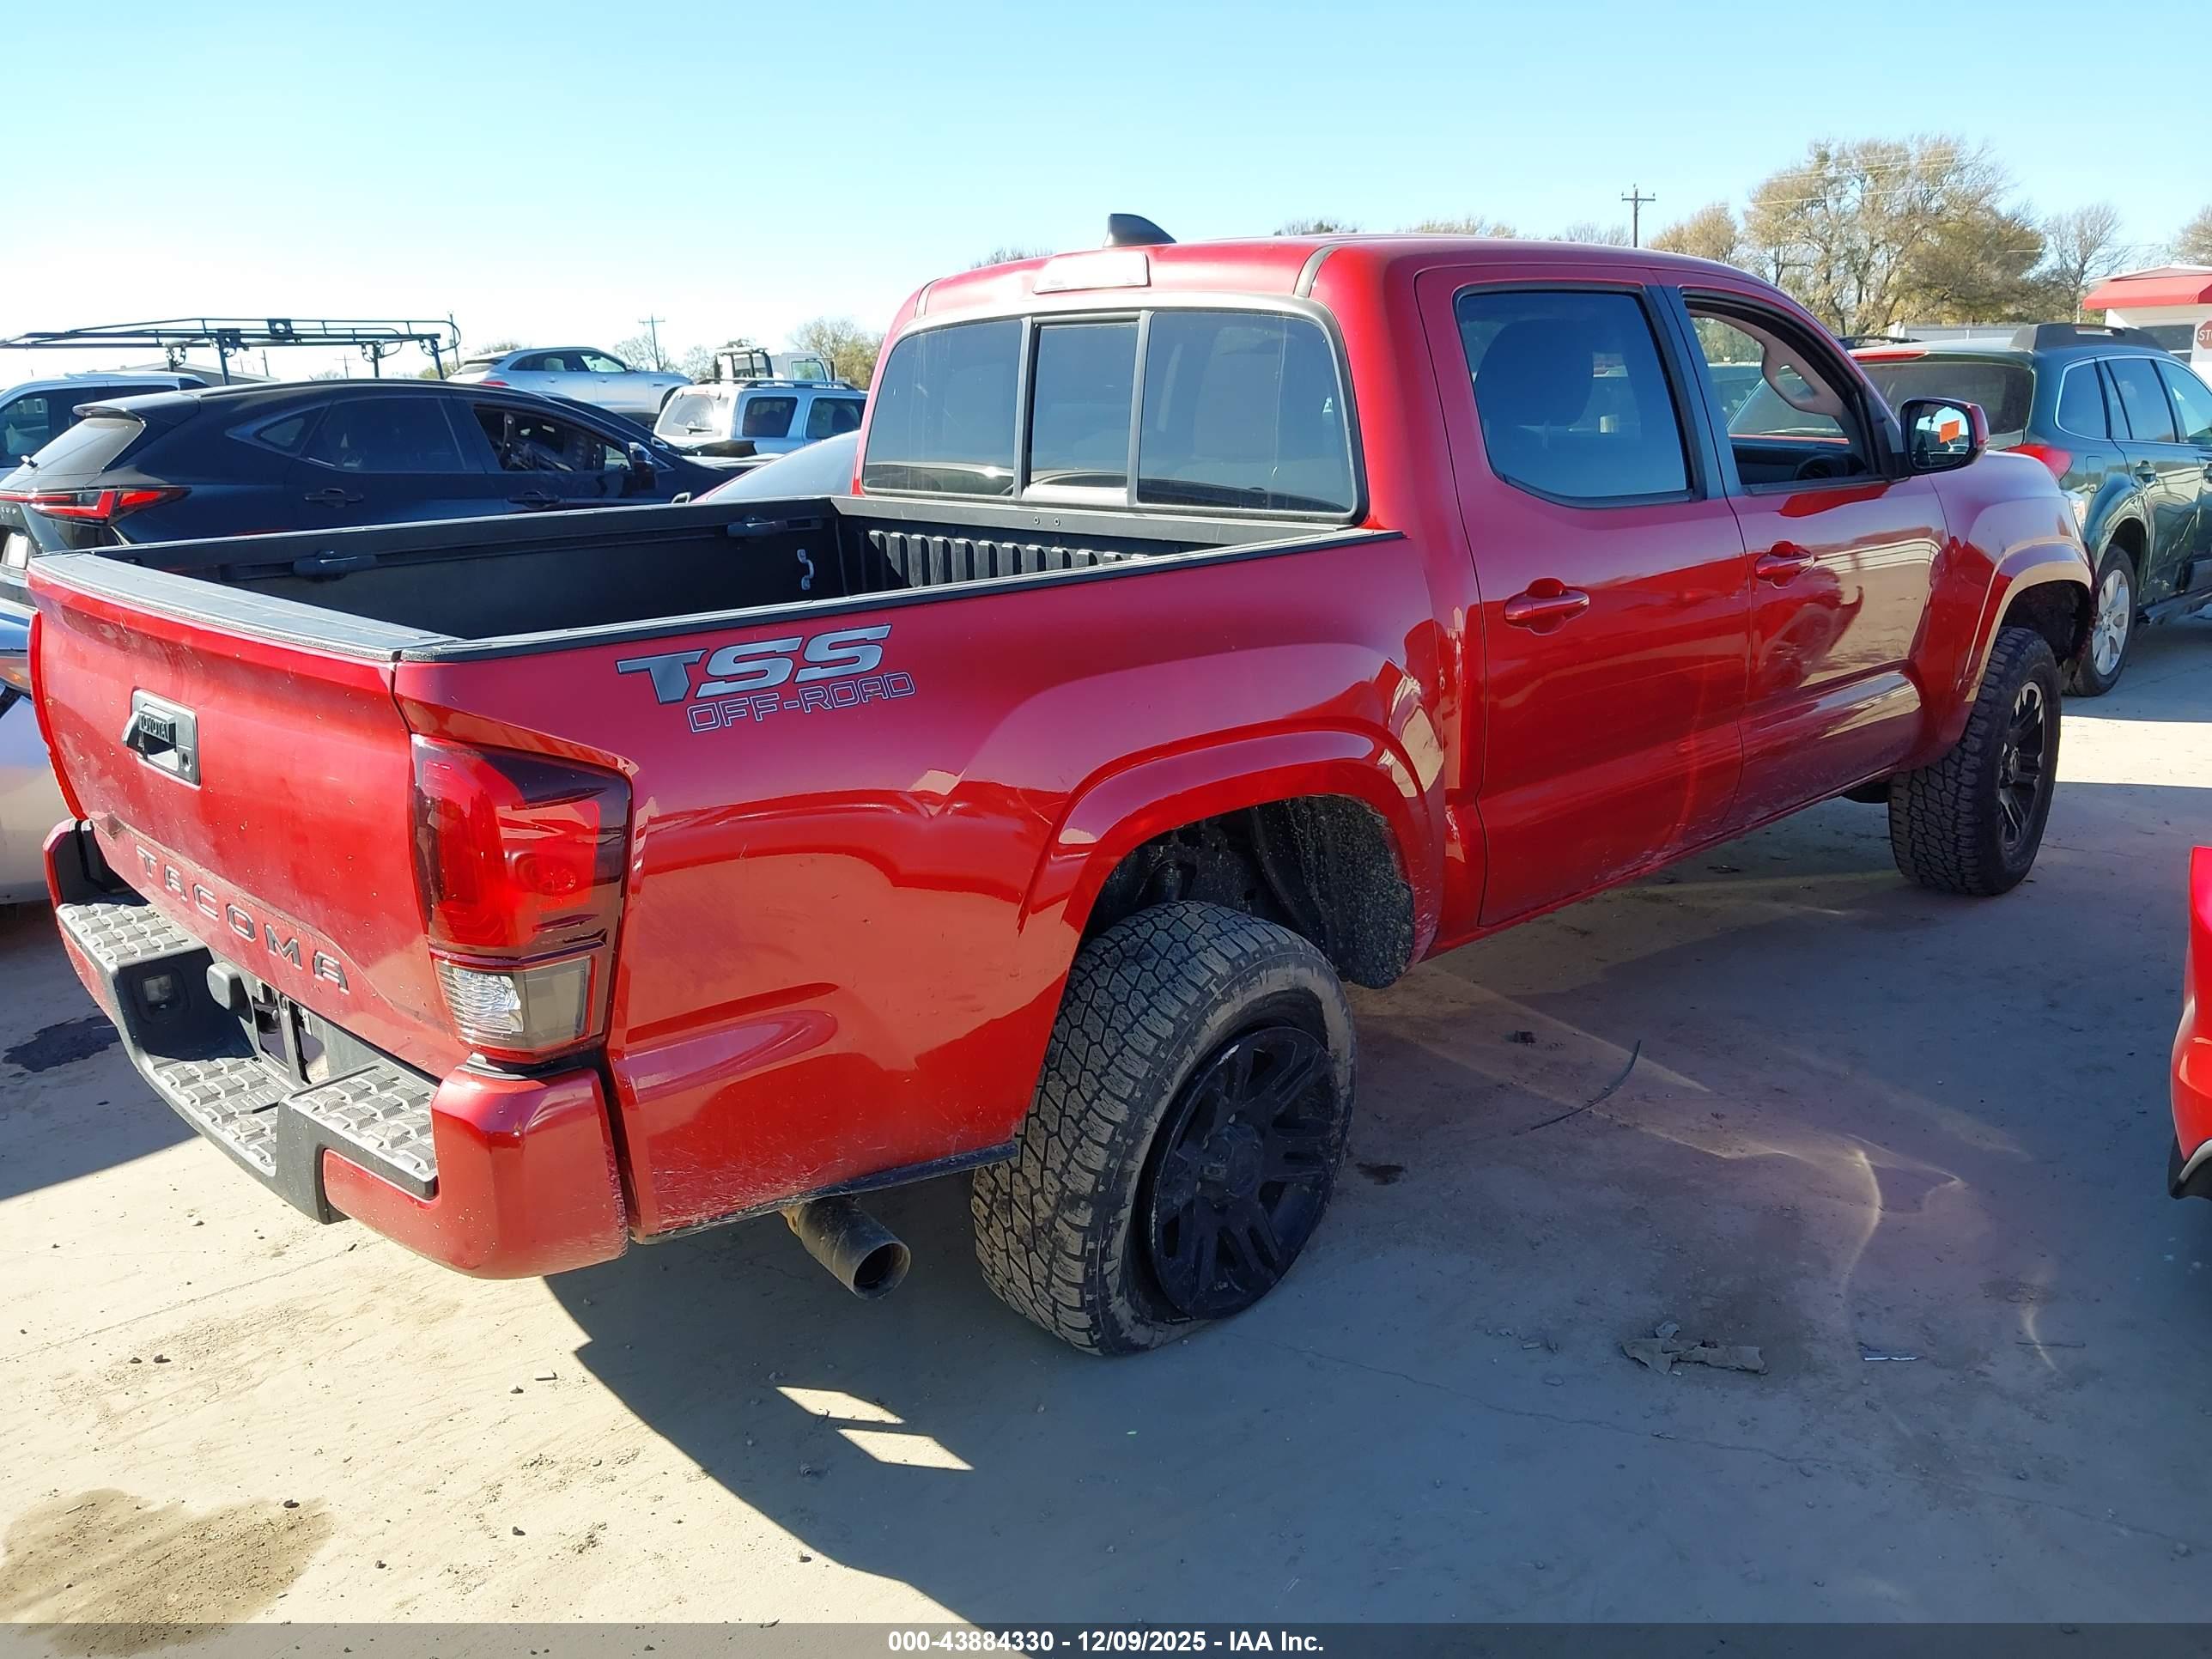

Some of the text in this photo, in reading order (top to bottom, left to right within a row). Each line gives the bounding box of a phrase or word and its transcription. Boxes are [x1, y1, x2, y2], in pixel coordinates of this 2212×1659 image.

[2198, 329, 2212, 341] ST
[616, 624, 892, 705] TSS
[687, 671, 915, 733] OFF-ROAD
[136, 844, 350, 995] TACOMA
